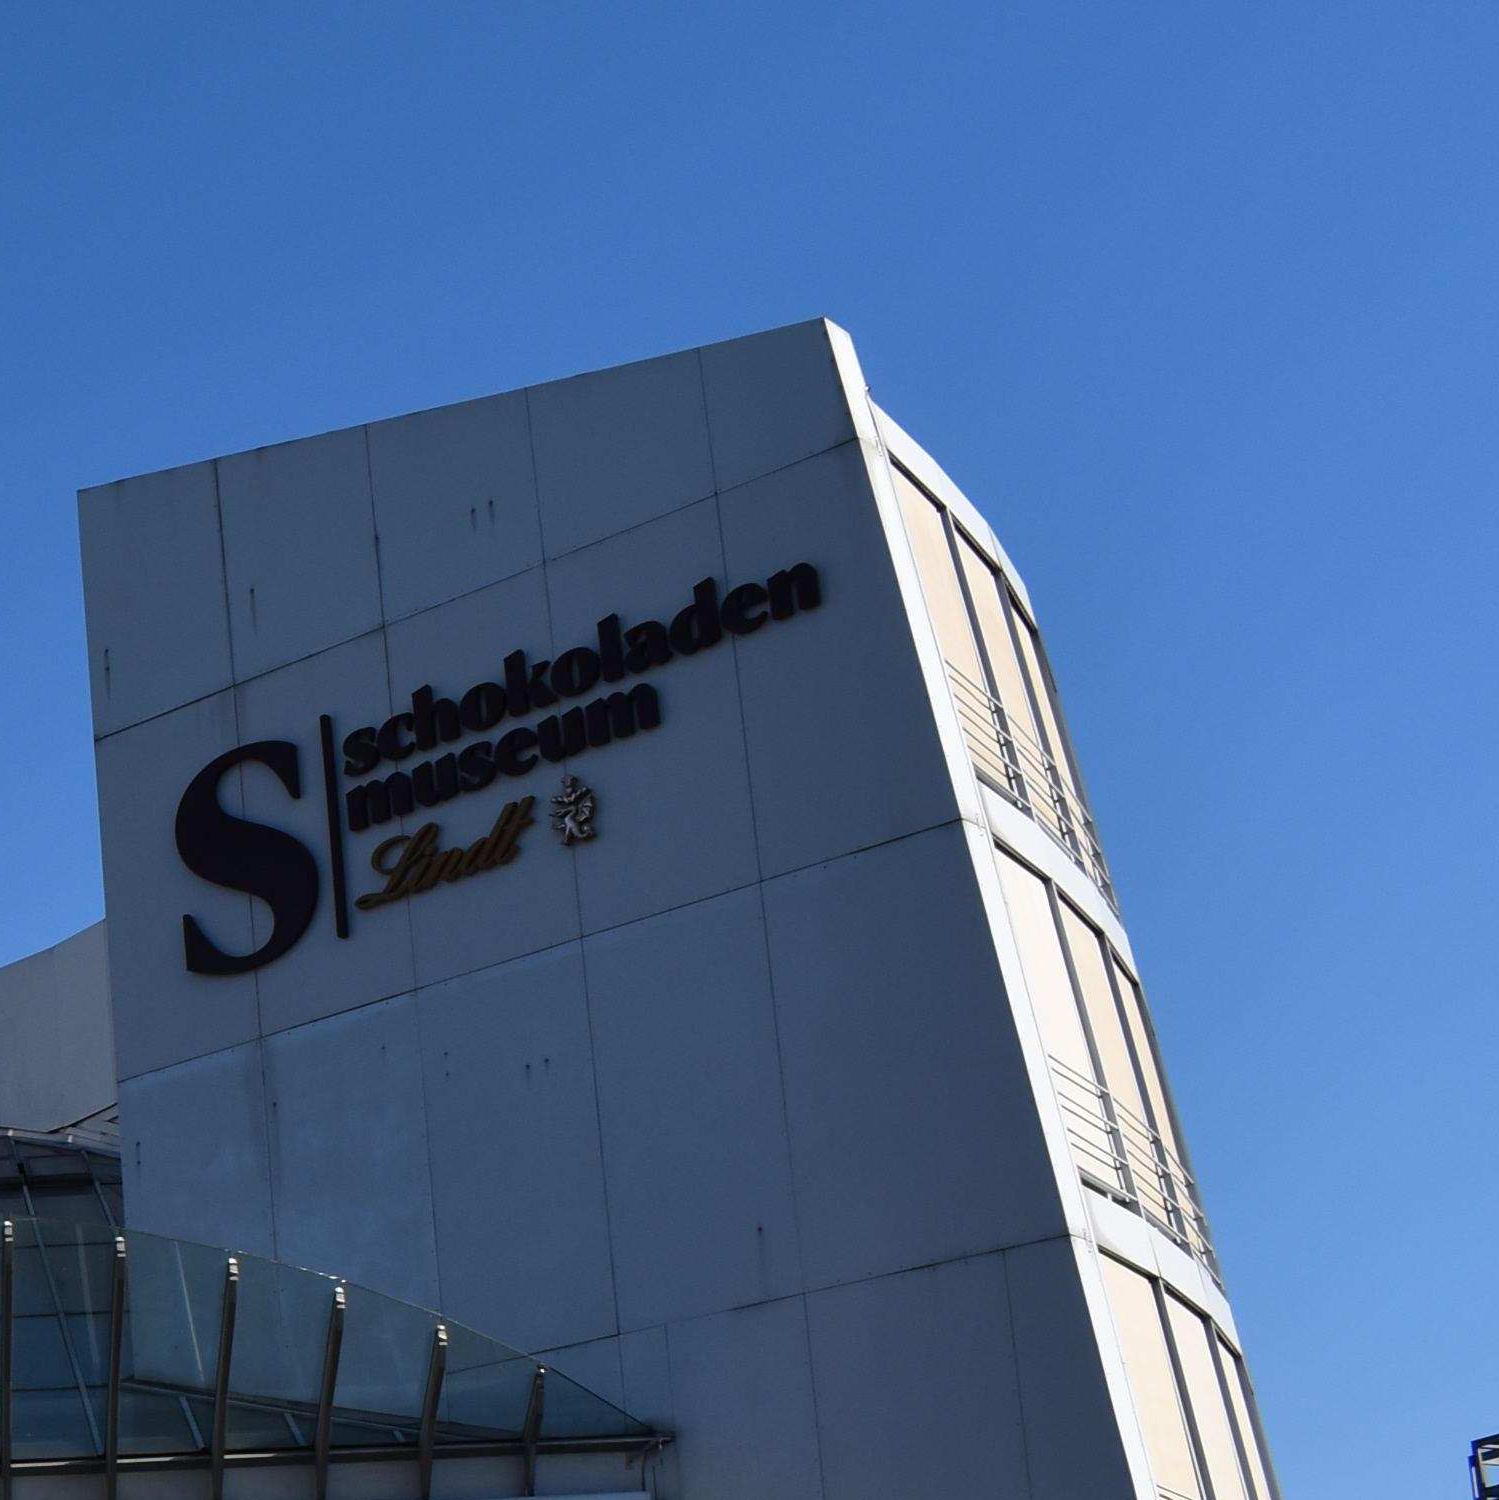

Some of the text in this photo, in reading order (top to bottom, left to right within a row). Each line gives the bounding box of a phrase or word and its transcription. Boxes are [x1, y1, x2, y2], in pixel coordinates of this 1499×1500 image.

[343, 562, 822, 776] schokoladen
[345, 682, 660, 833] museum
[175, 740, 320, 975] S
[354, 795, 537, 910] Lindt
